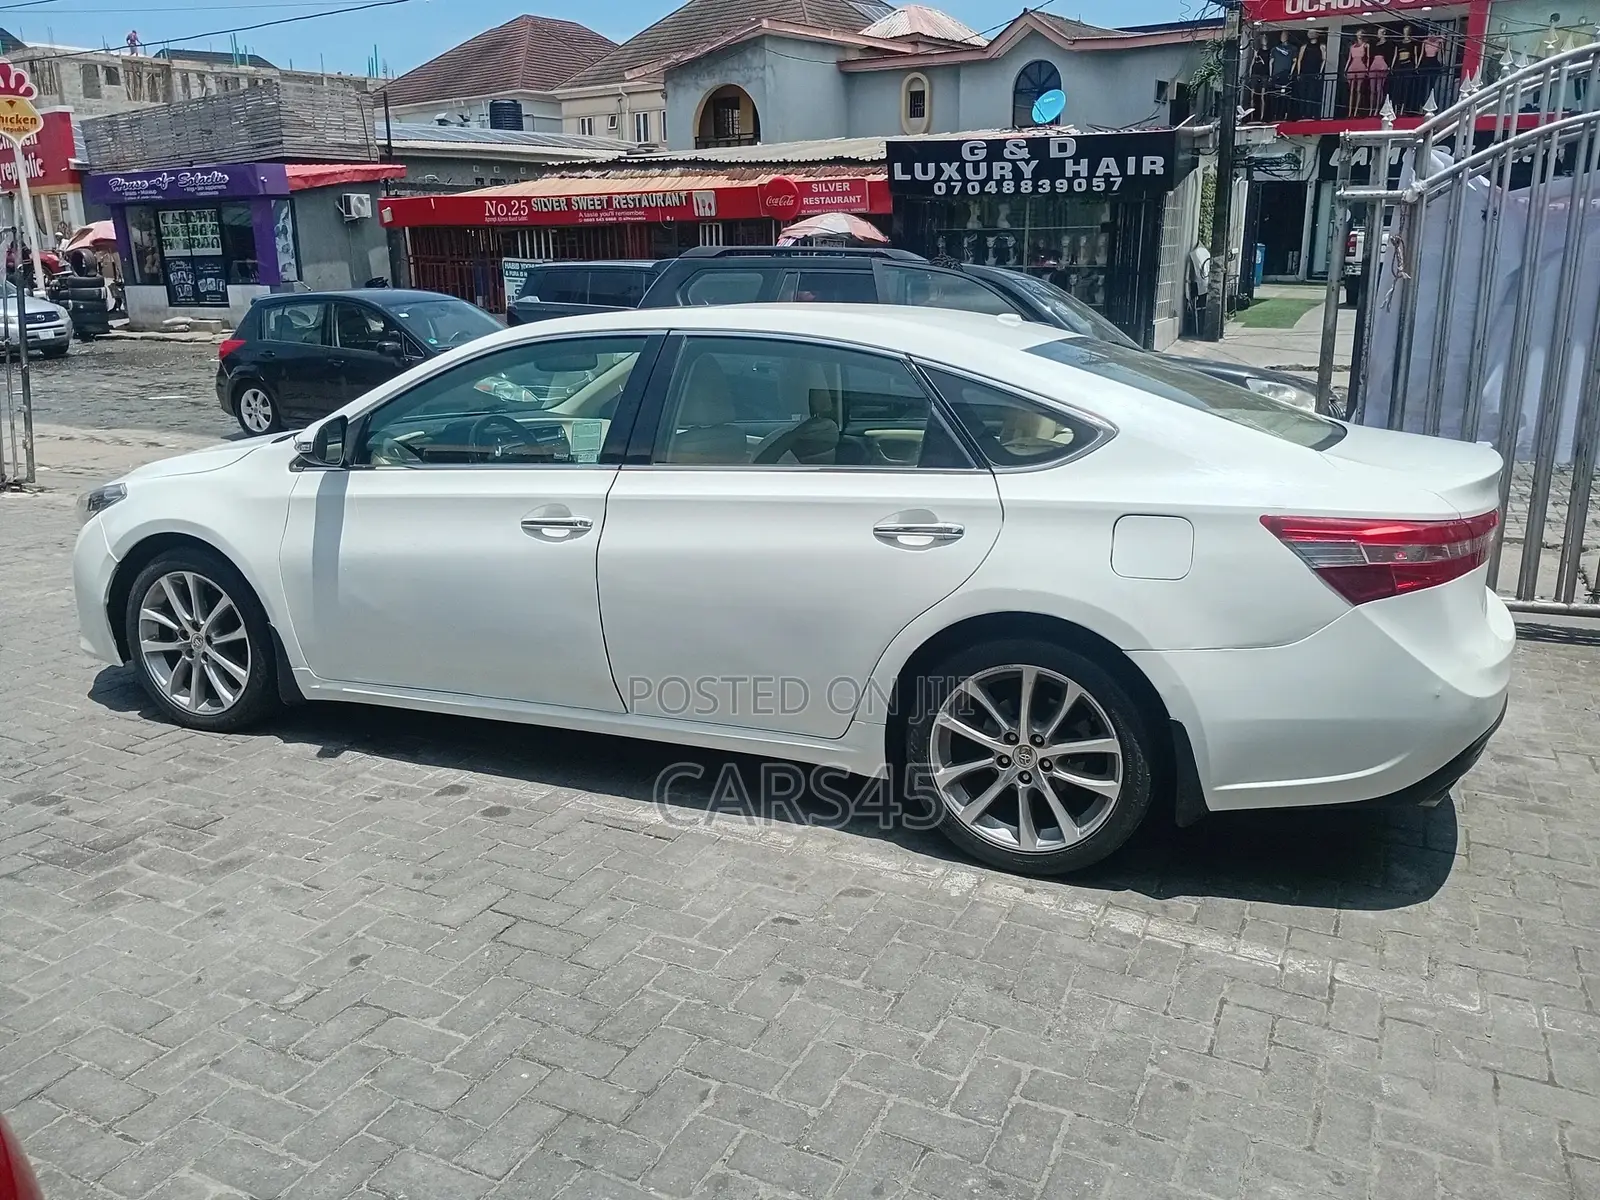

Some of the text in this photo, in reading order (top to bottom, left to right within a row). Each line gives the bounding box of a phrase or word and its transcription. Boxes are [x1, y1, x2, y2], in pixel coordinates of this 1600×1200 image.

[961, 137, 1076, 161] G & D
[893, 156, 1165, 181] LUXURY HAIR
[109, 177, 148, 191] House
[811, 182, 851, 193] SILVER
[933, 177, 1123, 195] 07048839057
[484, 192, 687, 216] No.25 SILVER SWEET RESTAURANT
[803, 195, 862, 205] RESTAURANT
